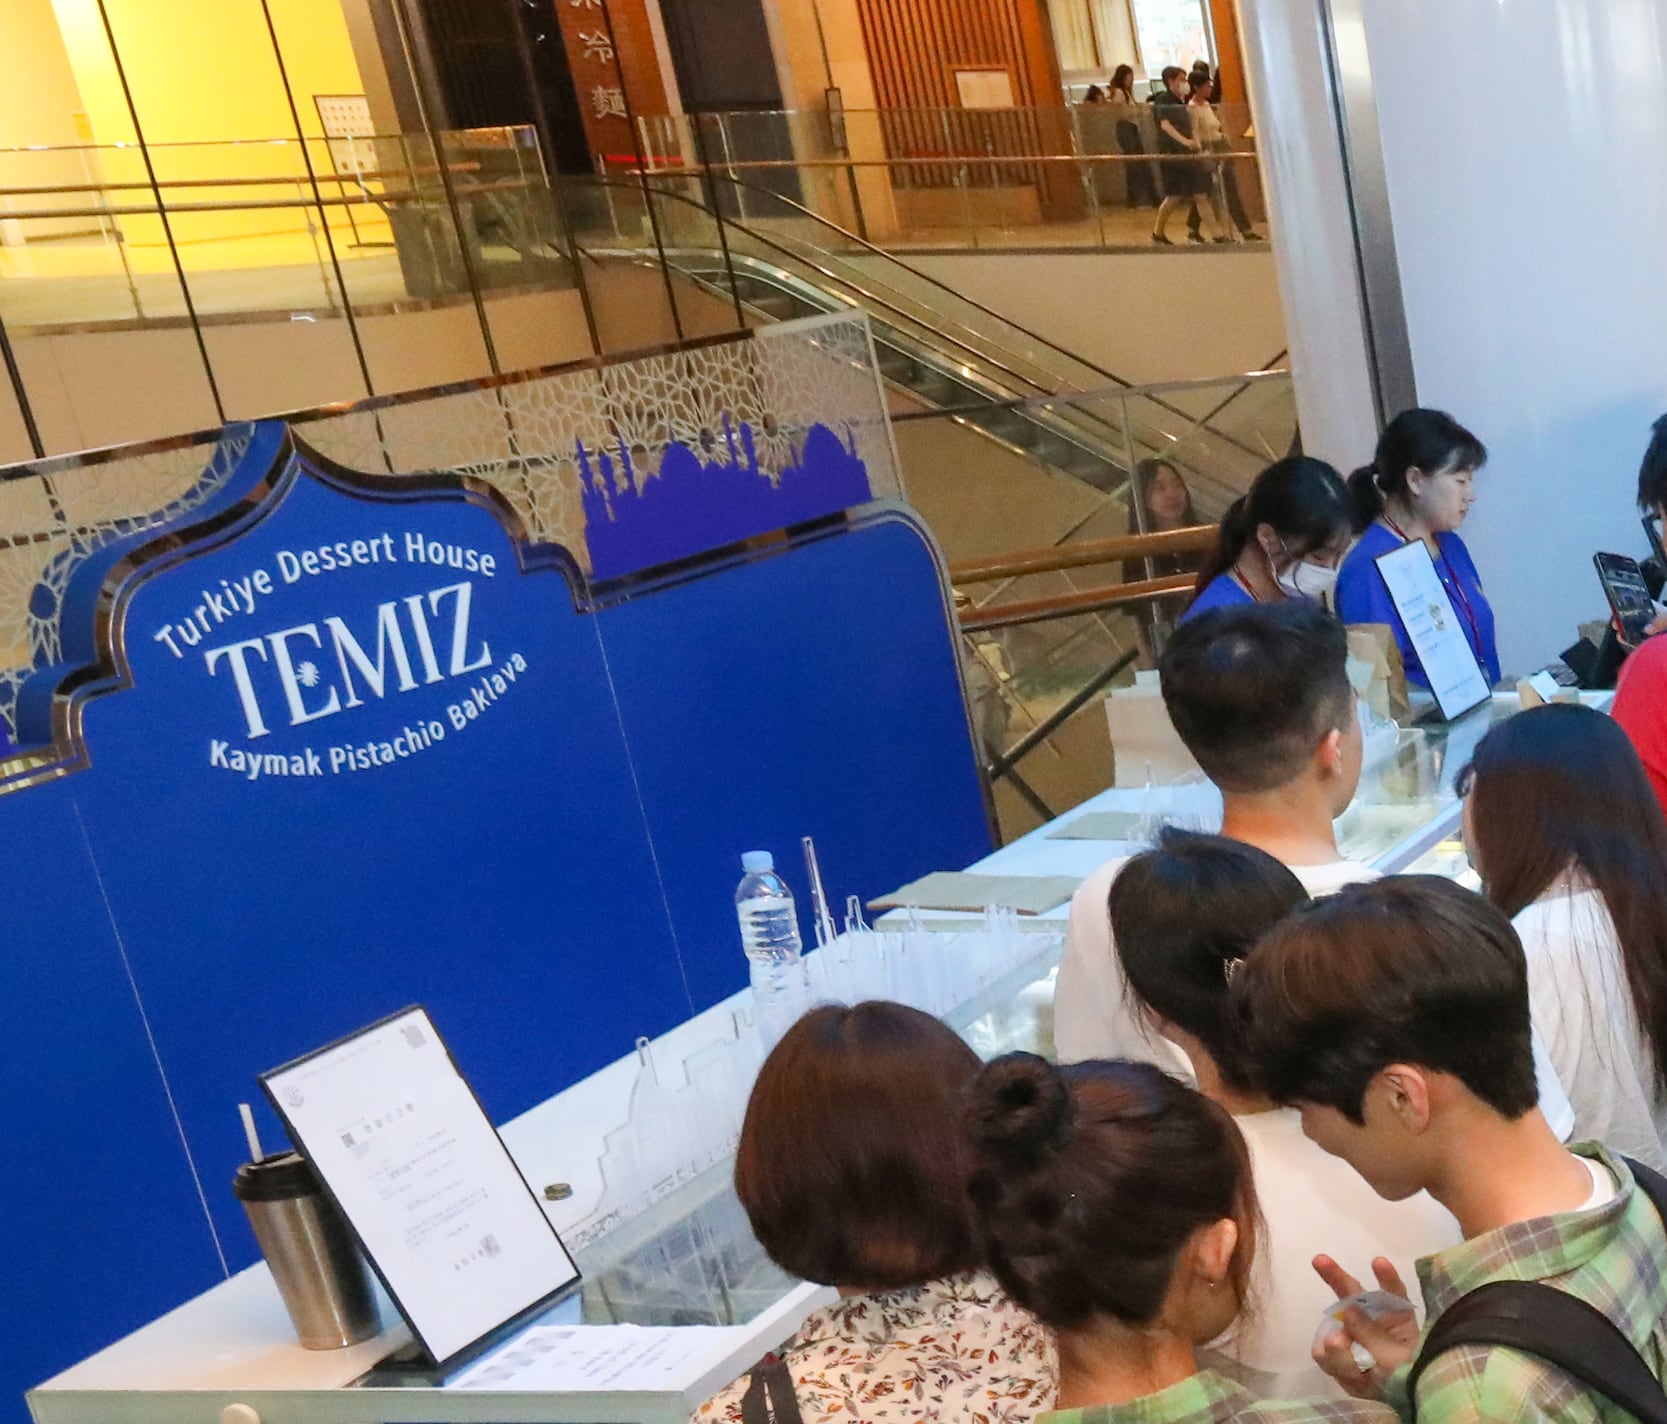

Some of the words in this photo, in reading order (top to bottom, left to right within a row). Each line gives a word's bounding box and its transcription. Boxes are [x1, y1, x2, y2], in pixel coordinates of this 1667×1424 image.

[154, 568, 273, 659] Turkiye
[276, 532, 397, 585] Dessert
[404, 531, 496, 577] House
[204, 581, 493, 739] TEMIZ
[210, 739, 323, 781] Kaymak
[330, 720, 445, 774] Pistachio
[446, 652, 528, 732] Baklava
